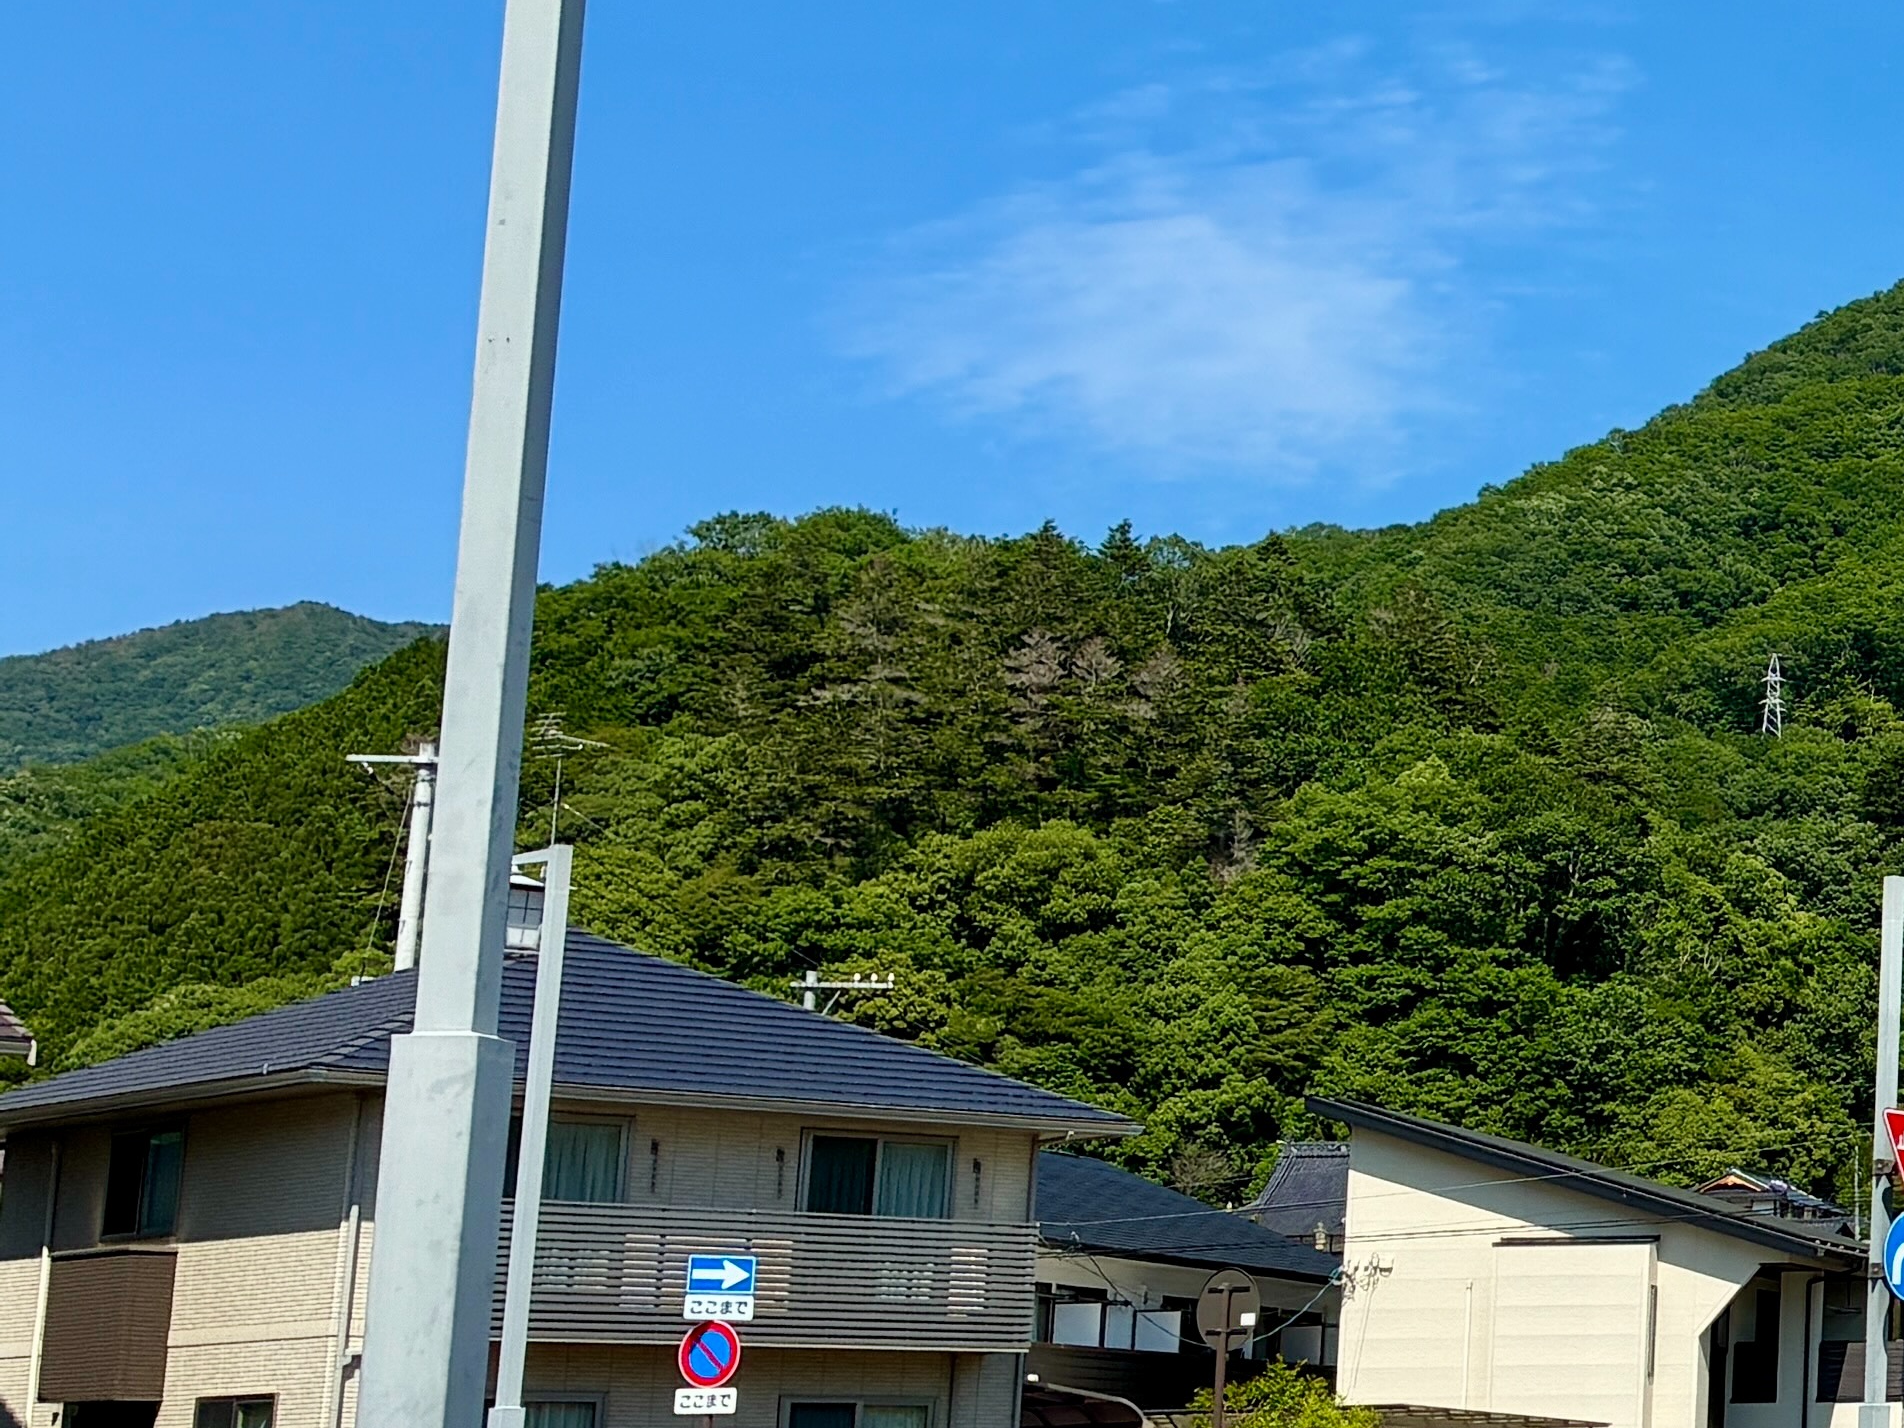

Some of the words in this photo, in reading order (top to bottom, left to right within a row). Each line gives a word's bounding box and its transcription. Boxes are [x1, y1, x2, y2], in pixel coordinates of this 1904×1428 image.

[690, 1300, 748, 1315] ここまで
[679, 1394, 731, 1409] ここまで
